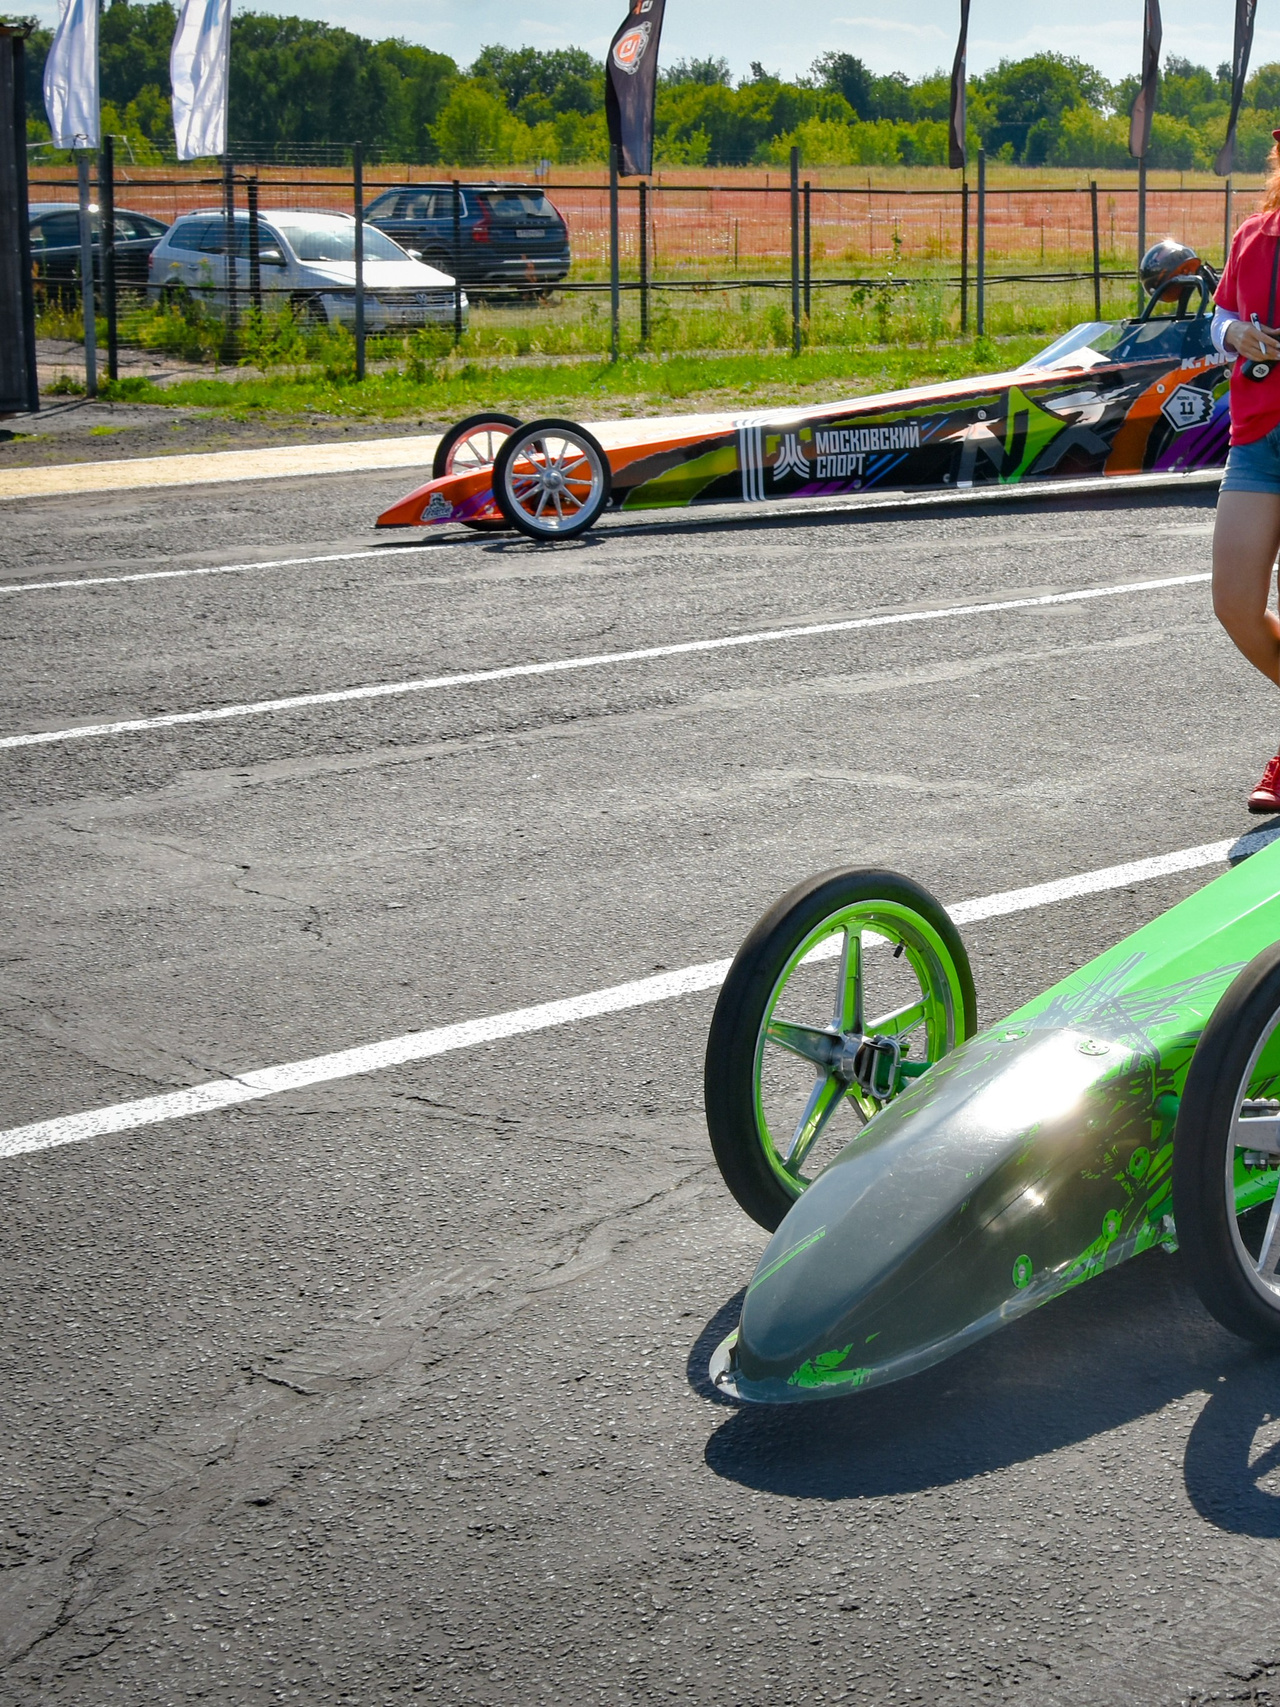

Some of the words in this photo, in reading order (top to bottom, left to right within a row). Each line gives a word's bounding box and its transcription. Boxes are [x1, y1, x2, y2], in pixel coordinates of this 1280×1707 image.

[1180, 401, 1195, 416] 11
[815, 421, 920, 454] МОСКОВСКИЙ
[816, 453, 866, 478] СПОРТ
